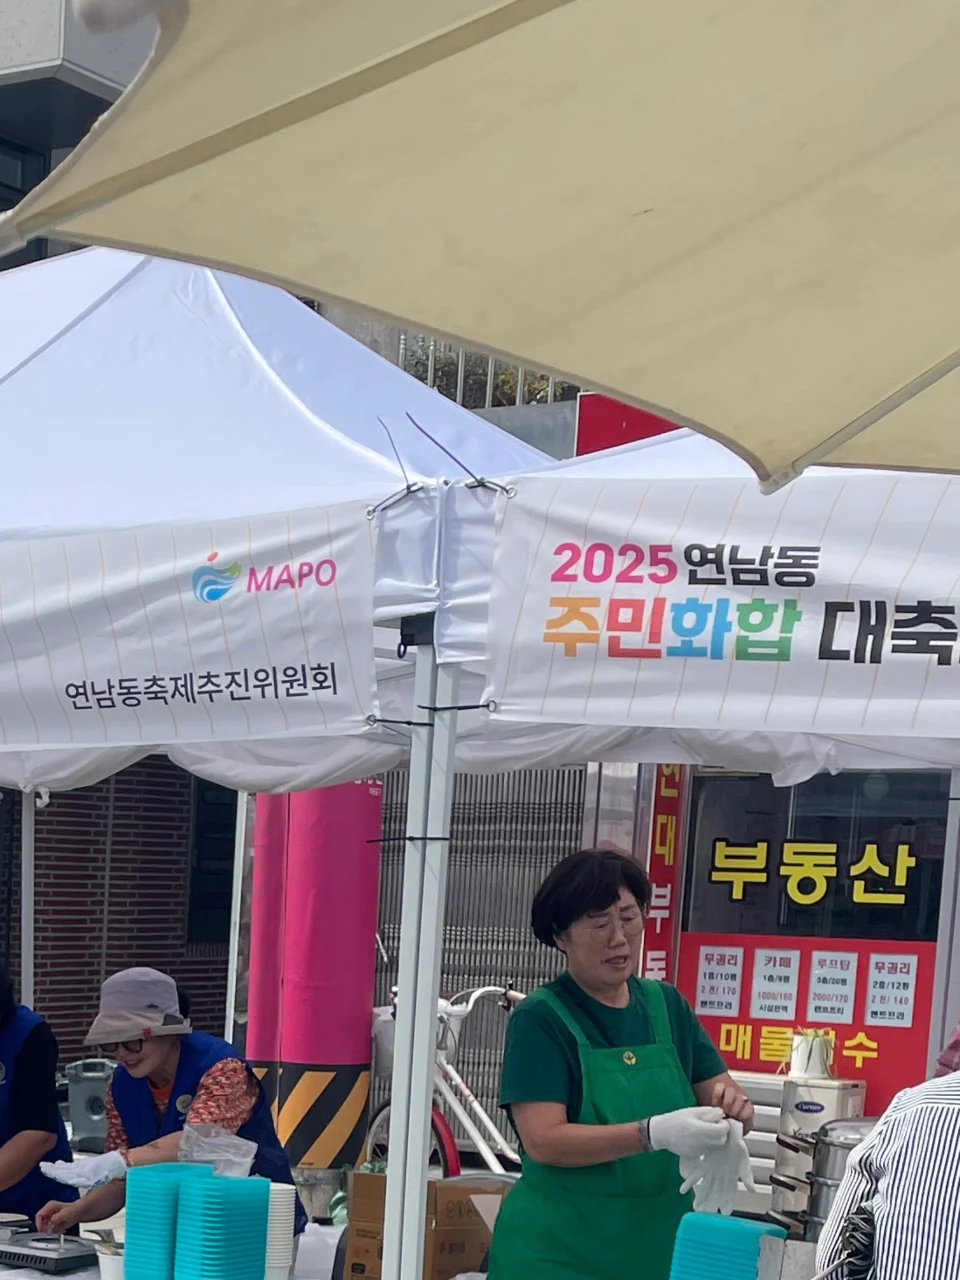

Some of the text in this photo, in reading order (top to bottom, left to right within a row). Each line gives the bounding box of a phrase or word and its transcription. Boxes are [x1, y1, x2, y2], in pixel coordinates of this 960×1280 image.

[247, 558, 337, 593] MAPO
[543, 596, 960, 666] 주민화합 대축
[64, 661, 338, 712] 연남동축제추진위원회
[711, 841, 917, 905] 부동산
[704, 953, 738, 967] 무권리
[763, 955, 792, 968] 카페
[874, 961, 911, 975] 무권리
[719, 1023, 878, 1068] 매물수
